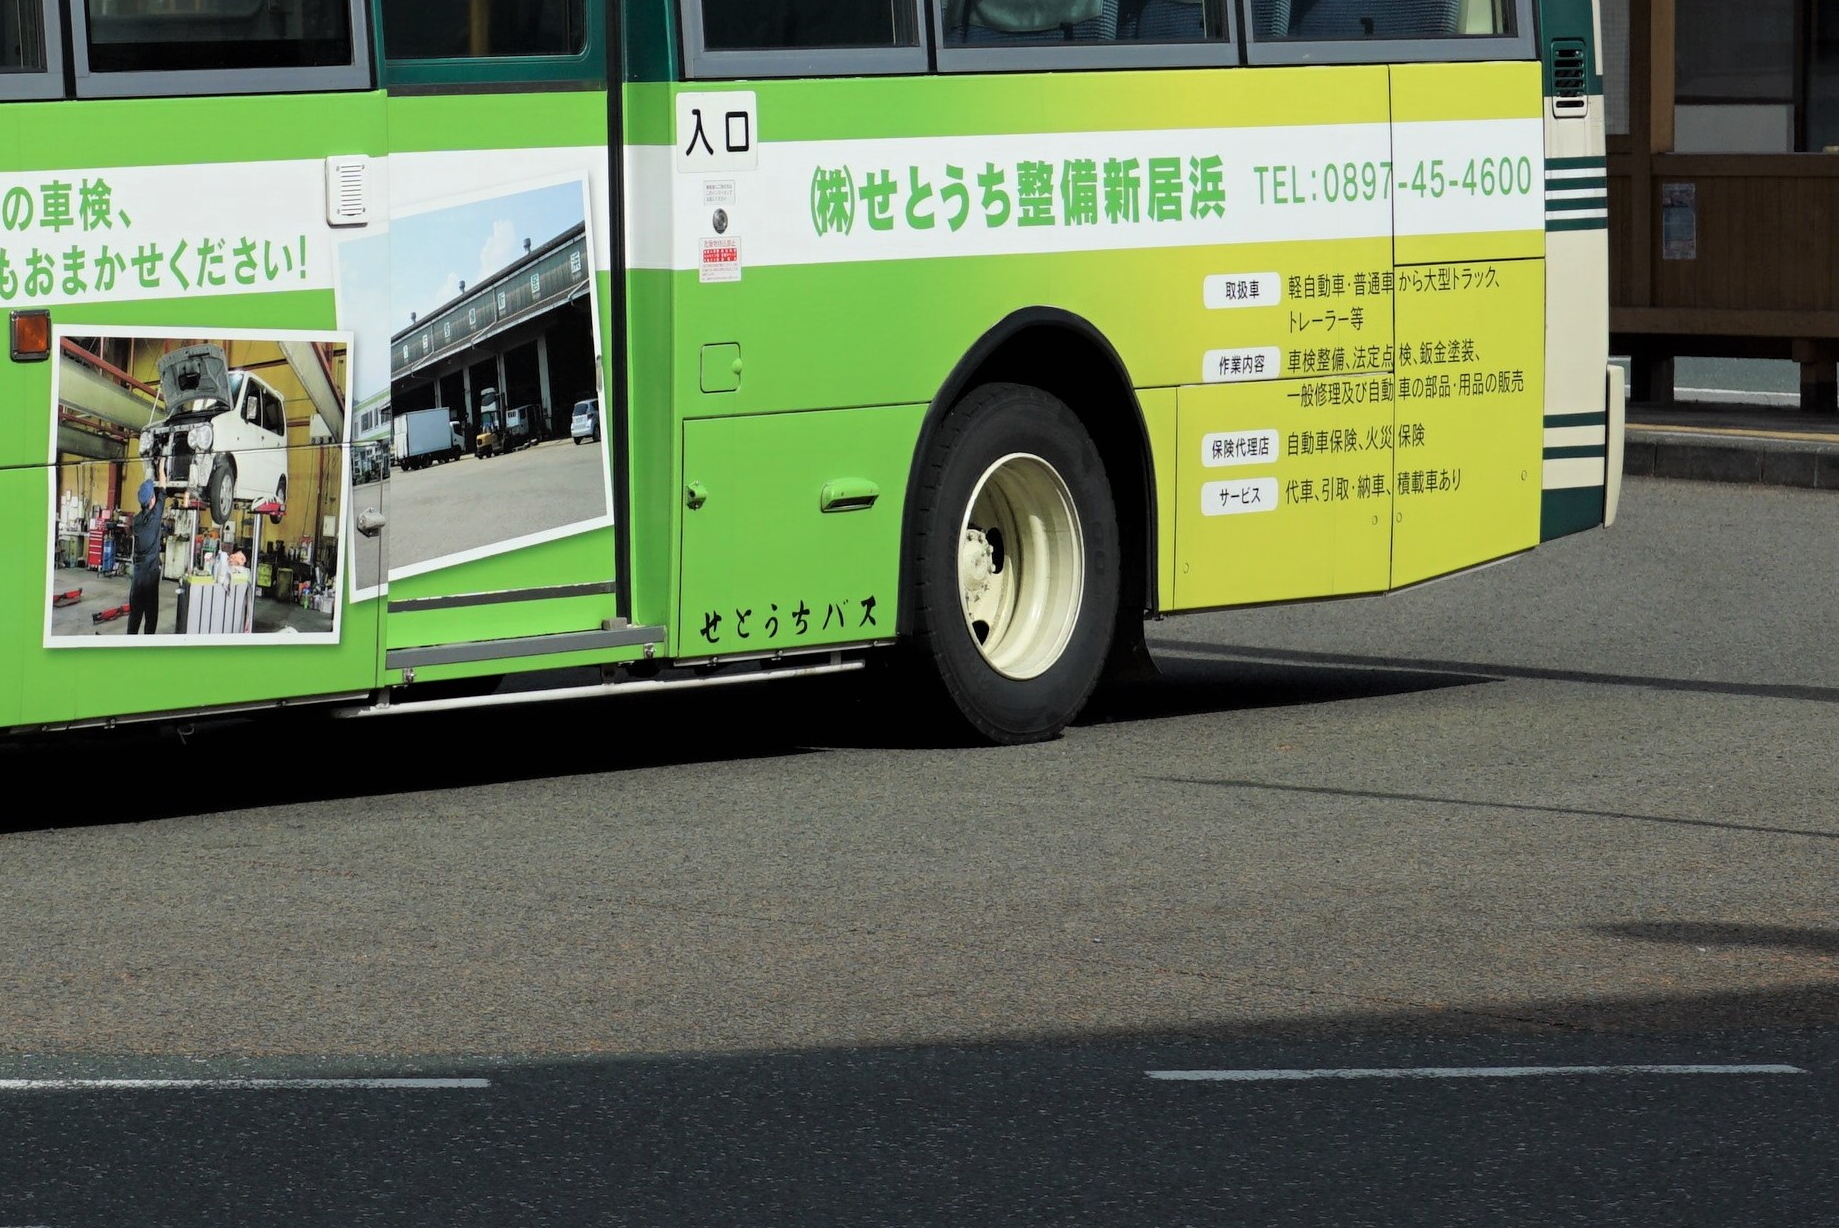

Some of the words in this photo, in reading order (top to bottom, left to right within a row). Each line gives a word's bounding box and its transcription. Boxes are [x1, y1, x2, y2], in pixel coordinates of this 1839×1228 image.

[685, 108, 750, 157] 入口
[1253, 155, 1532, 205] TEL:0897-45-4600
[1225, 279, 1261, 300] 取扱車
[1289, 306, 1364, 334] トレーラー等
[1219, 353, 1265, 376] 作業内容
[1211, 436, 1270, 460] 保険代理店
[1219, 486, 1261, 507] サービス
[700, 594, 877, 644] せとうちバス
